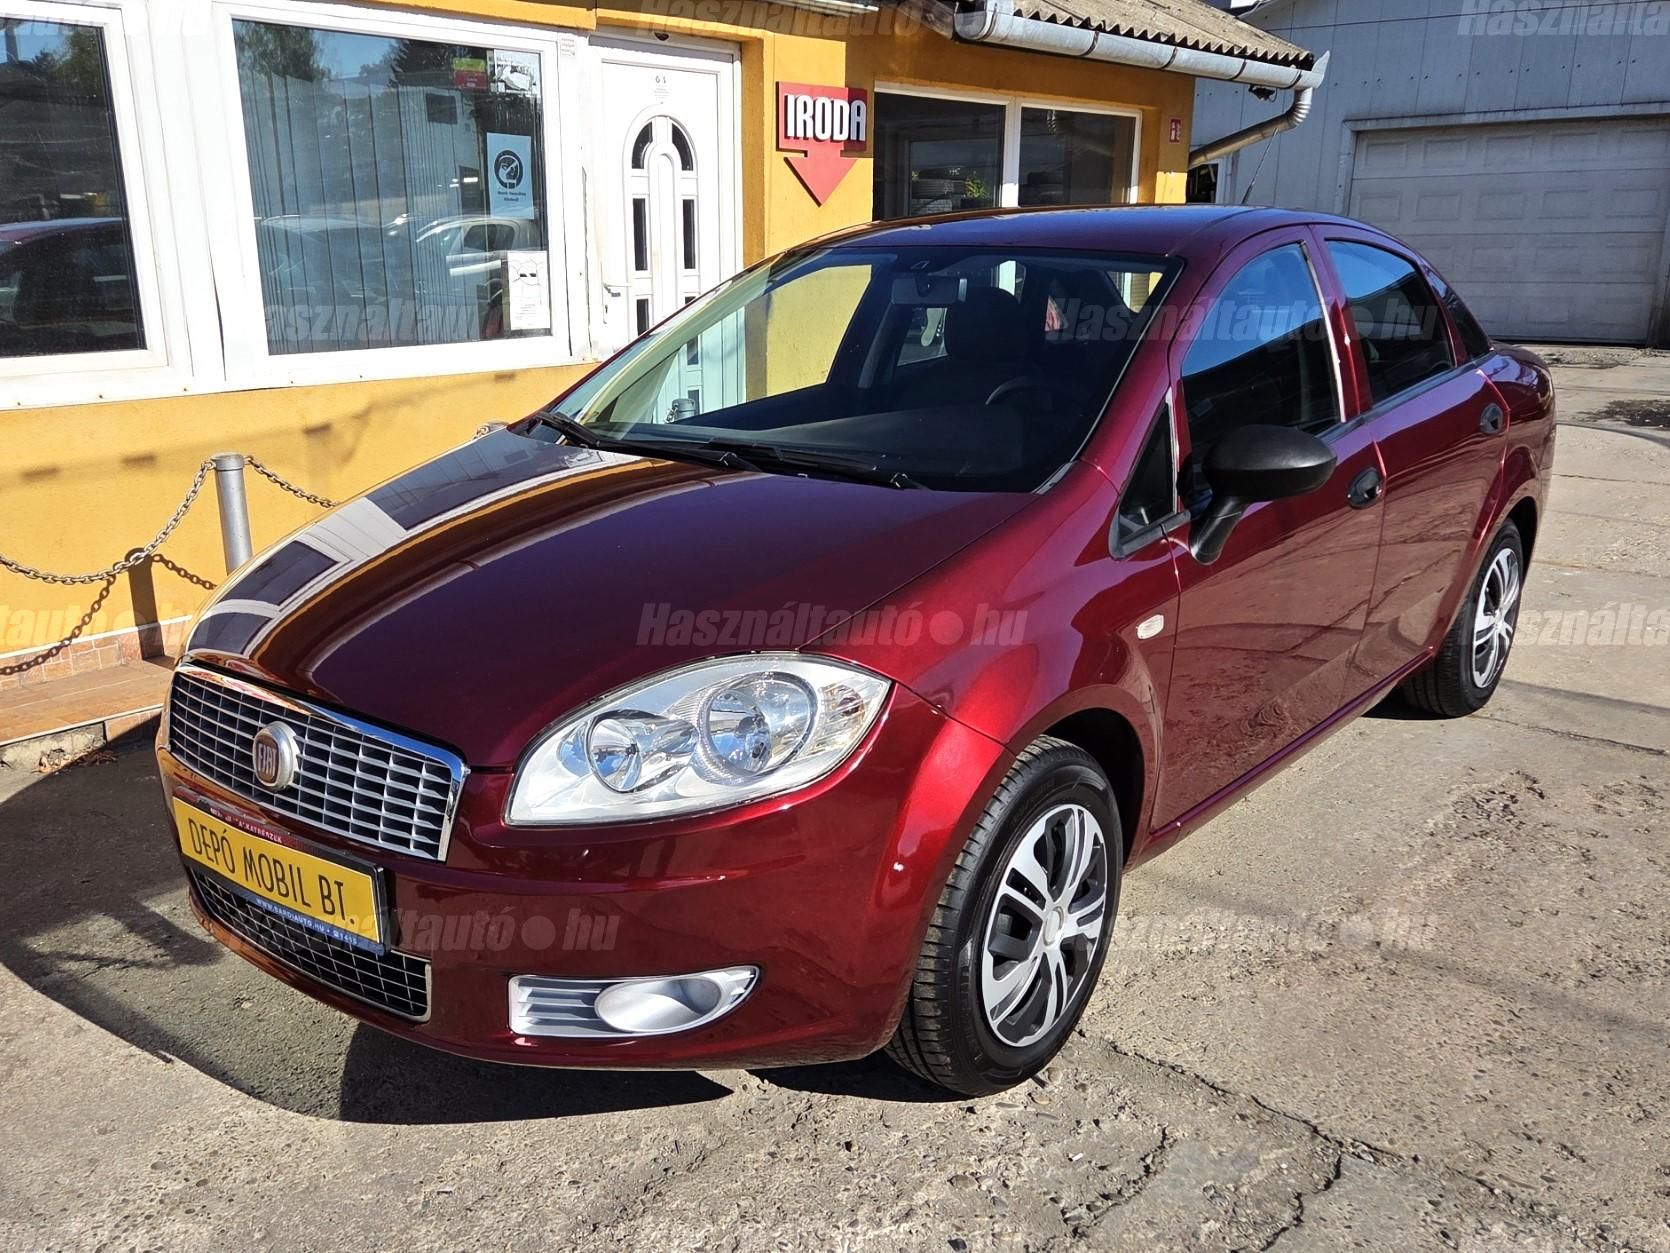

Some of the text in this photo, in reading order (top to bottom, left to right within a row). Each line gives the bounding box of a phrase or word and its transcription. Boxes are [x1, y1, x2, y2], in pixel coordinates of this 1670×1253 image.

[785, 93, 867, 141] IRODA
[257, 743, 277, 777] FIAT
[187, 817, 355, 925] DEPÓ MOBIL BT.
